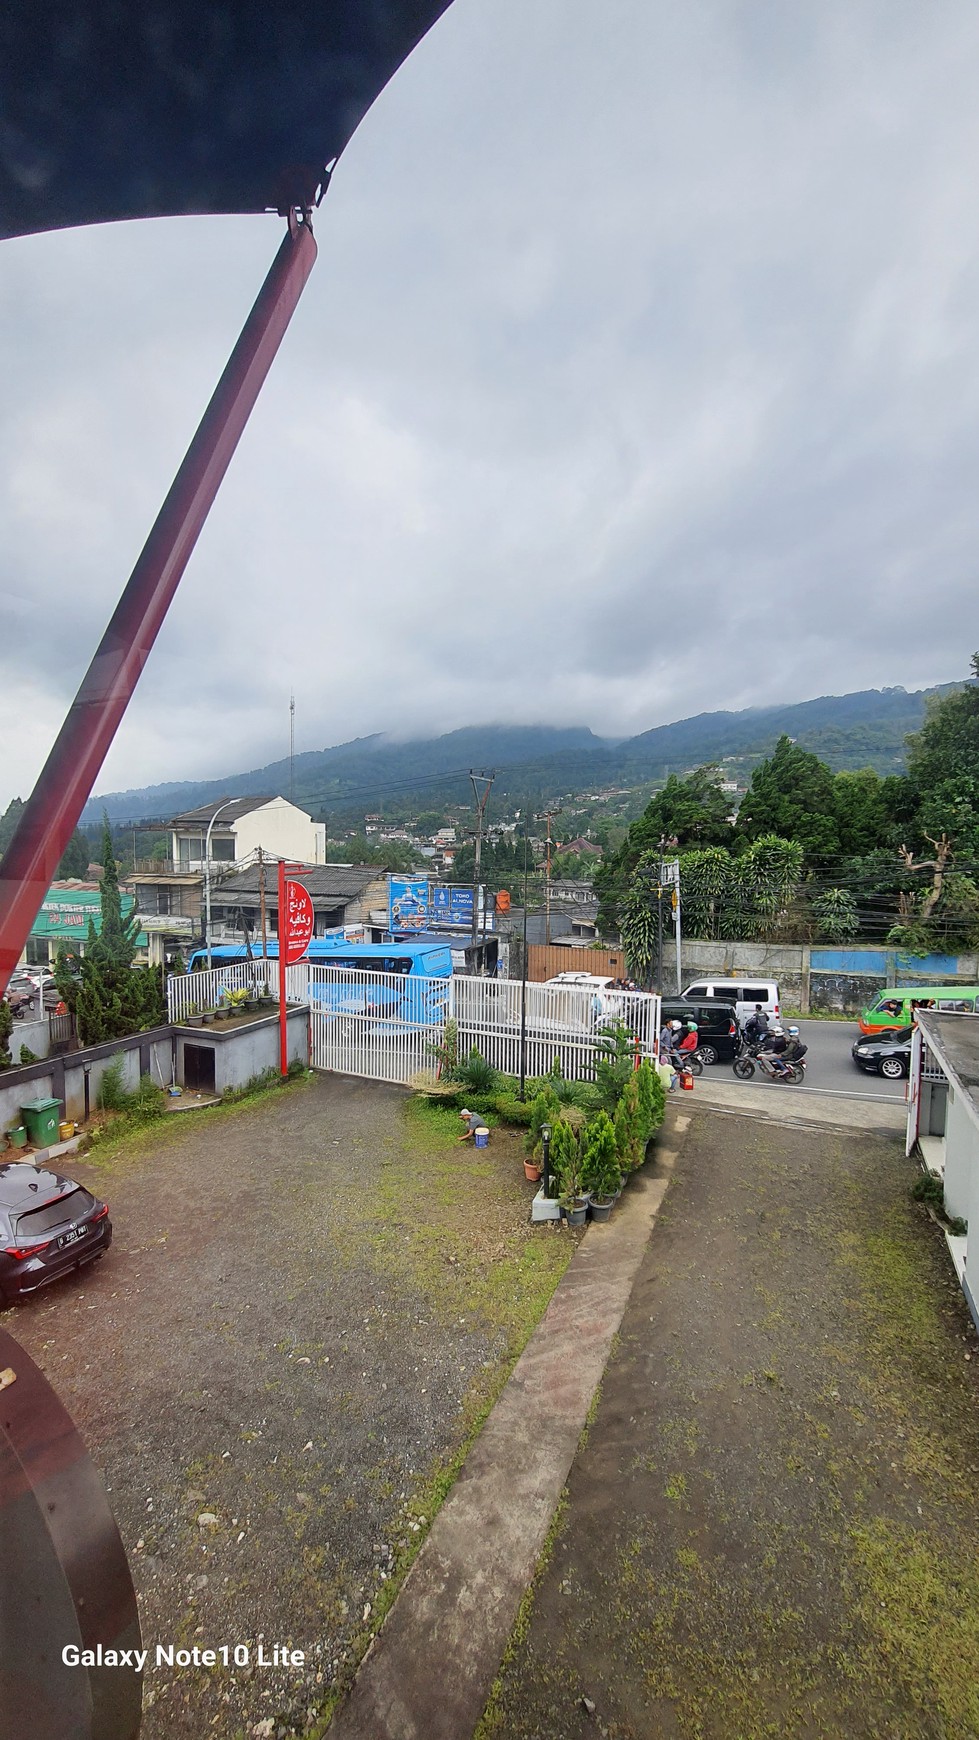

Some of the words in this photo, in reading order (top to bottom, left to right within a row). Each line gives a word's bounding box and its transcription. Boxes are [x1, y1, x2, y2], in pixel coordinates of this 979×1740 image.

[289, 899, 306, 913] لاونج
[48, 911, 61, 924] 24
[63, 914, 85, 926] JAM
